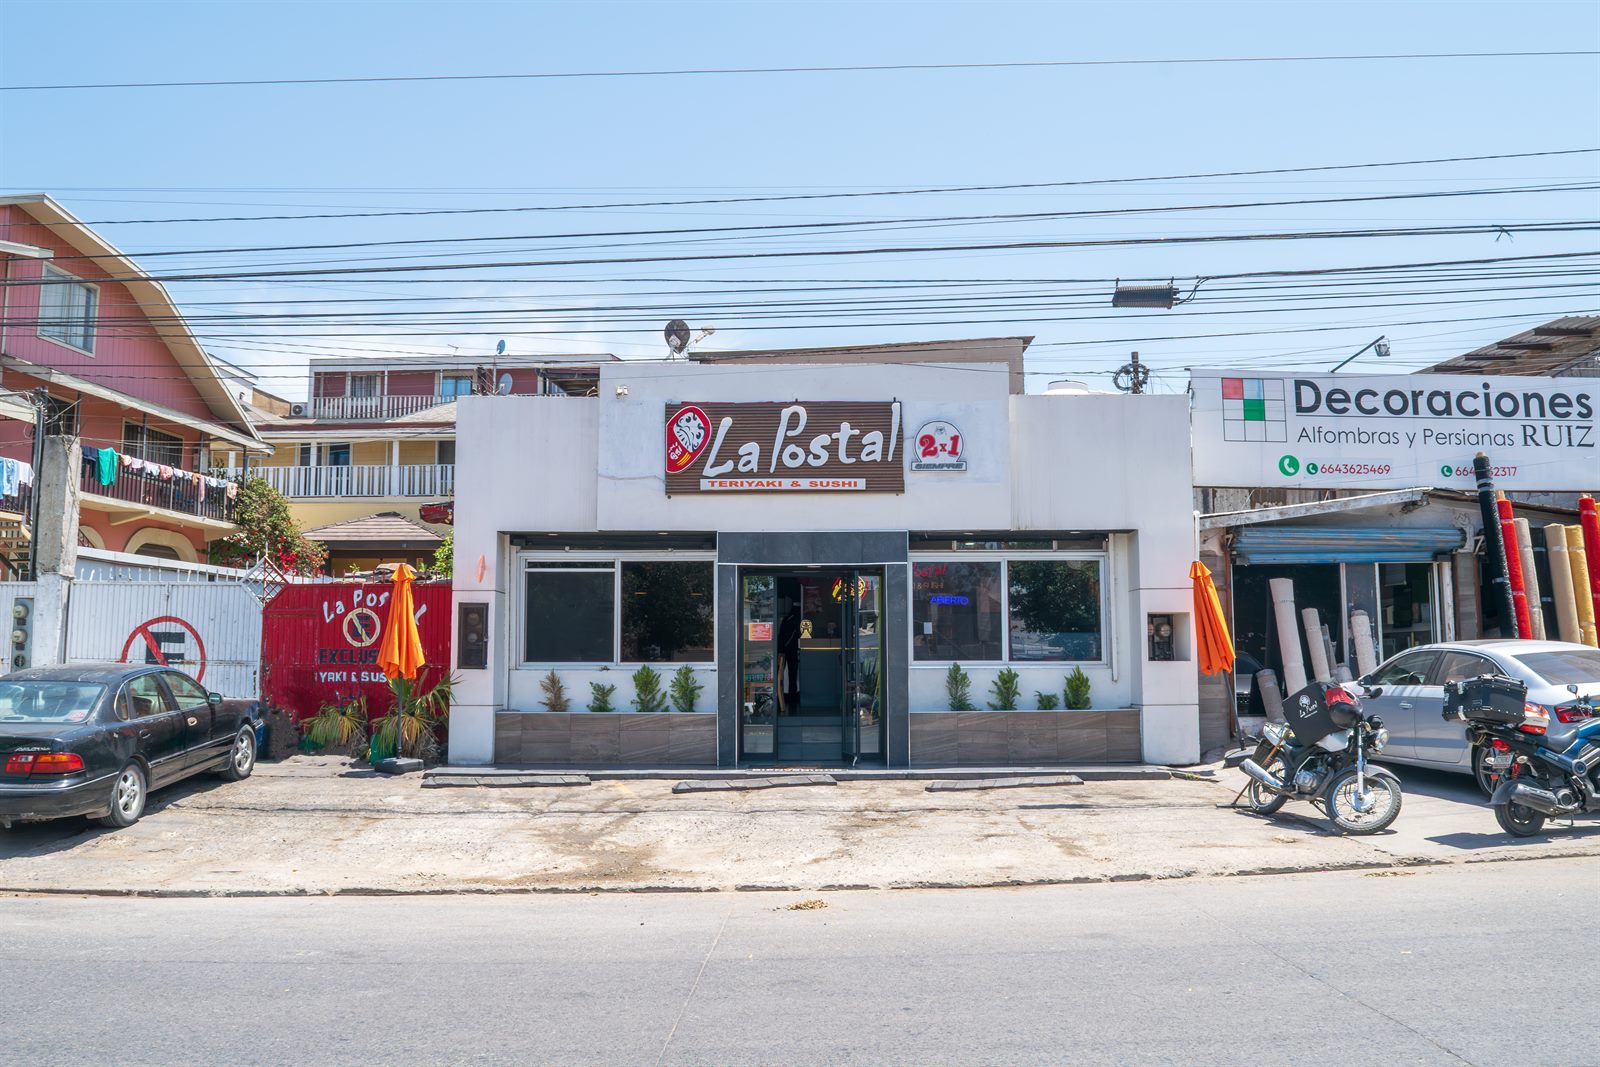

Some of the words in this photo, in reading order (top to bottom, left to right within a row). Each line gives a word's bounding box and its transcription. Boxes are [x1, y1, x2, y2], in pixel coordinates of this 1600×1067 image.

[1294, 379, 1593, 419] Decoraciones
[702, 416, 760, 477] La
[769, 402, 900, 474] Postal
[1297, 426, 1400, 445] Alfombras
[1405, 432, 1416, 448] y
[1423, 428, 1515, 447] Persianas
[1520, 424, 1595, 447] RUIZ
[918, 433, 960, 458] 2x1
[914, 462, 964, 470] SIEMPRE
[1320, 463, 1391, 475] 6643625469
[1455, 466, 1517, 477] 6642317
[708, 480, 783, 488] TERIYAKI
[790, 480, 801, 488] &
[808, 480, 858, 488] SUSHI
[322, 600, 345, 623] La
[319, 648, 379, 664] EXCLUS
[361, 671, 387, 683] SUS
